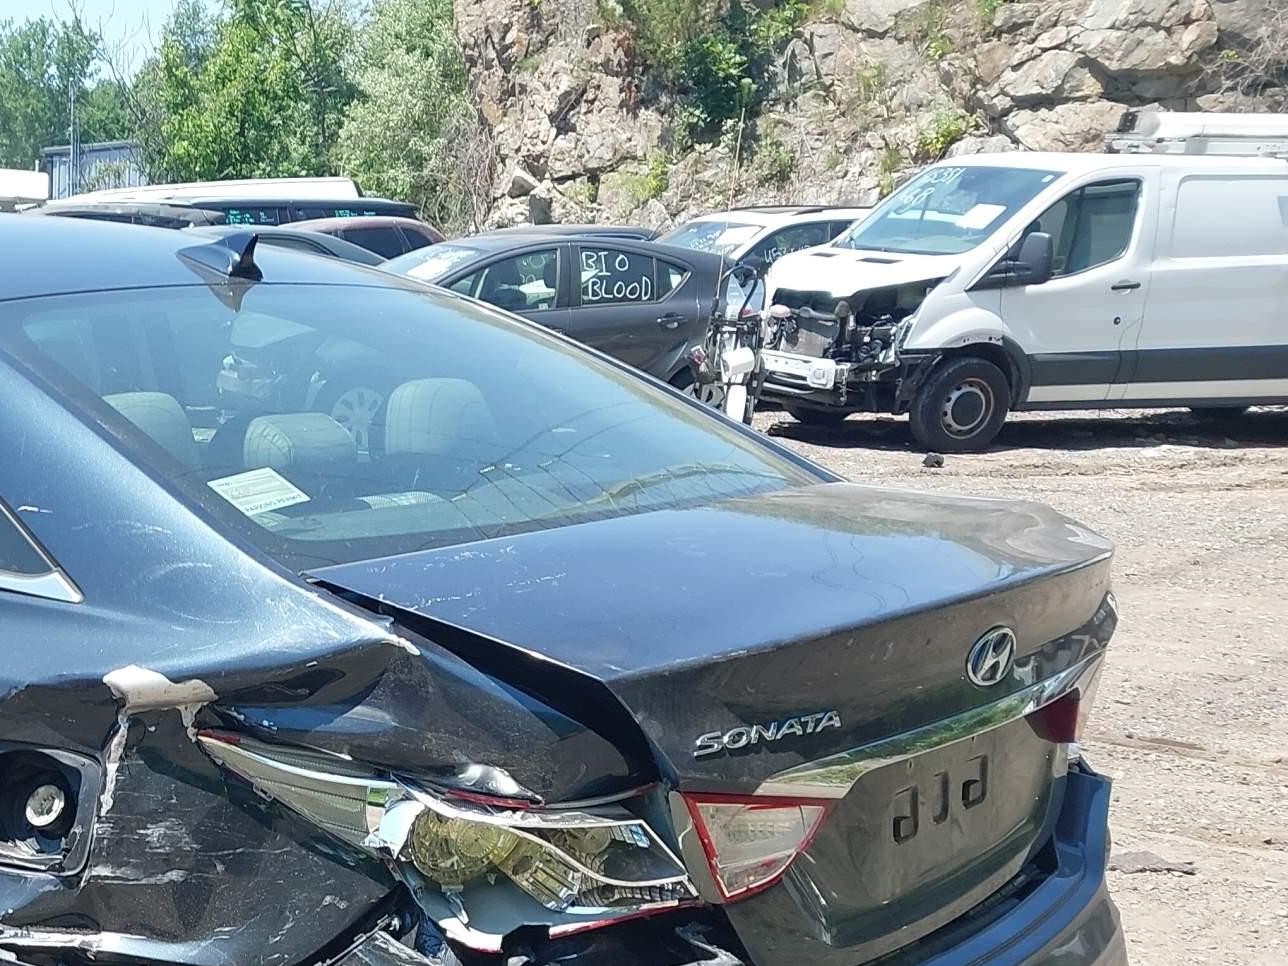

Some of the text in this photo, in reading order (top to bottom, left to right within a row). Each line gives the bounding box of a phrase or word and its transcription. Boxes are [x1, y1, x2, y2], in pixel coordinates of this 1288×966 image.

[581, 251, 629, 276] BIO
[588, 275, 651, 301] BLOOD
[693, 710, 842, 757] SONATA
